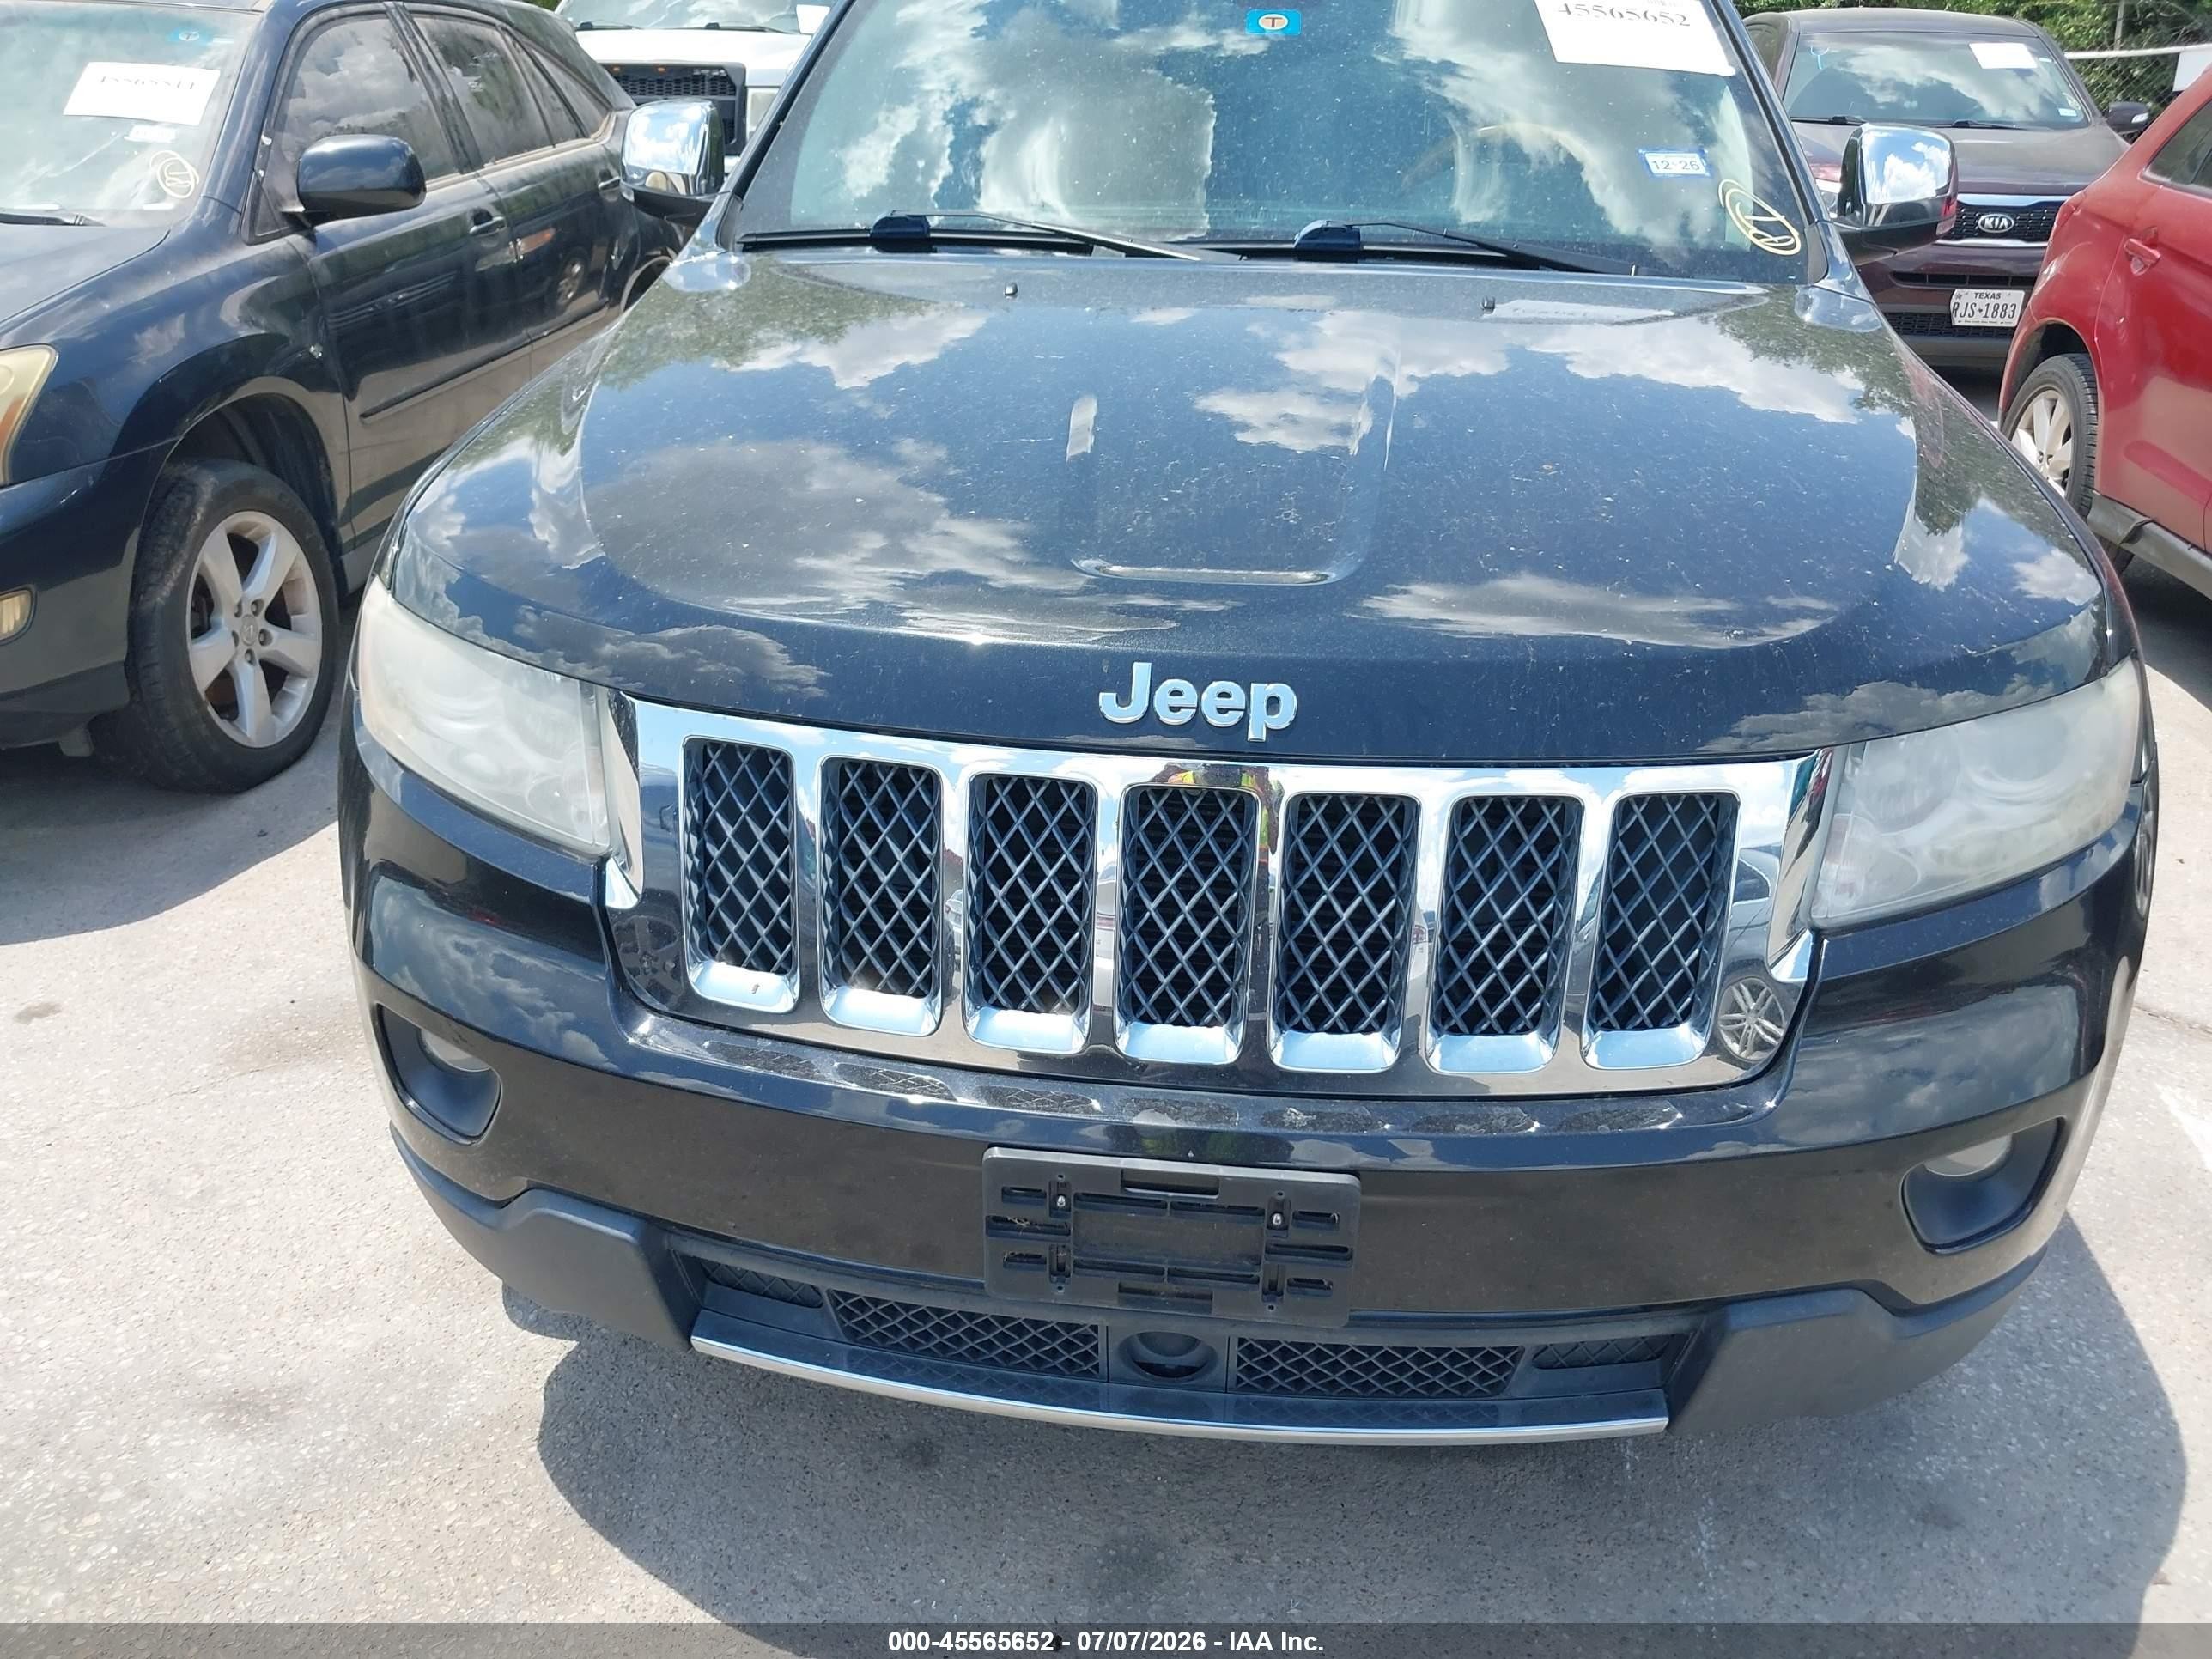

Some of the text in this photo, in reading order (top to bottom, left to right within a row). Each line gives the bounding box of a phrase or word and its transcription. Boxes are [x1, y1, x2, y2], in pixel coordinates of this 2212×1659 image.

[1558, 3, 1691, 27] 45565652
[1984, 217, 2008, 229] KIA
[1098, 661, 1298, 742] Jeep
